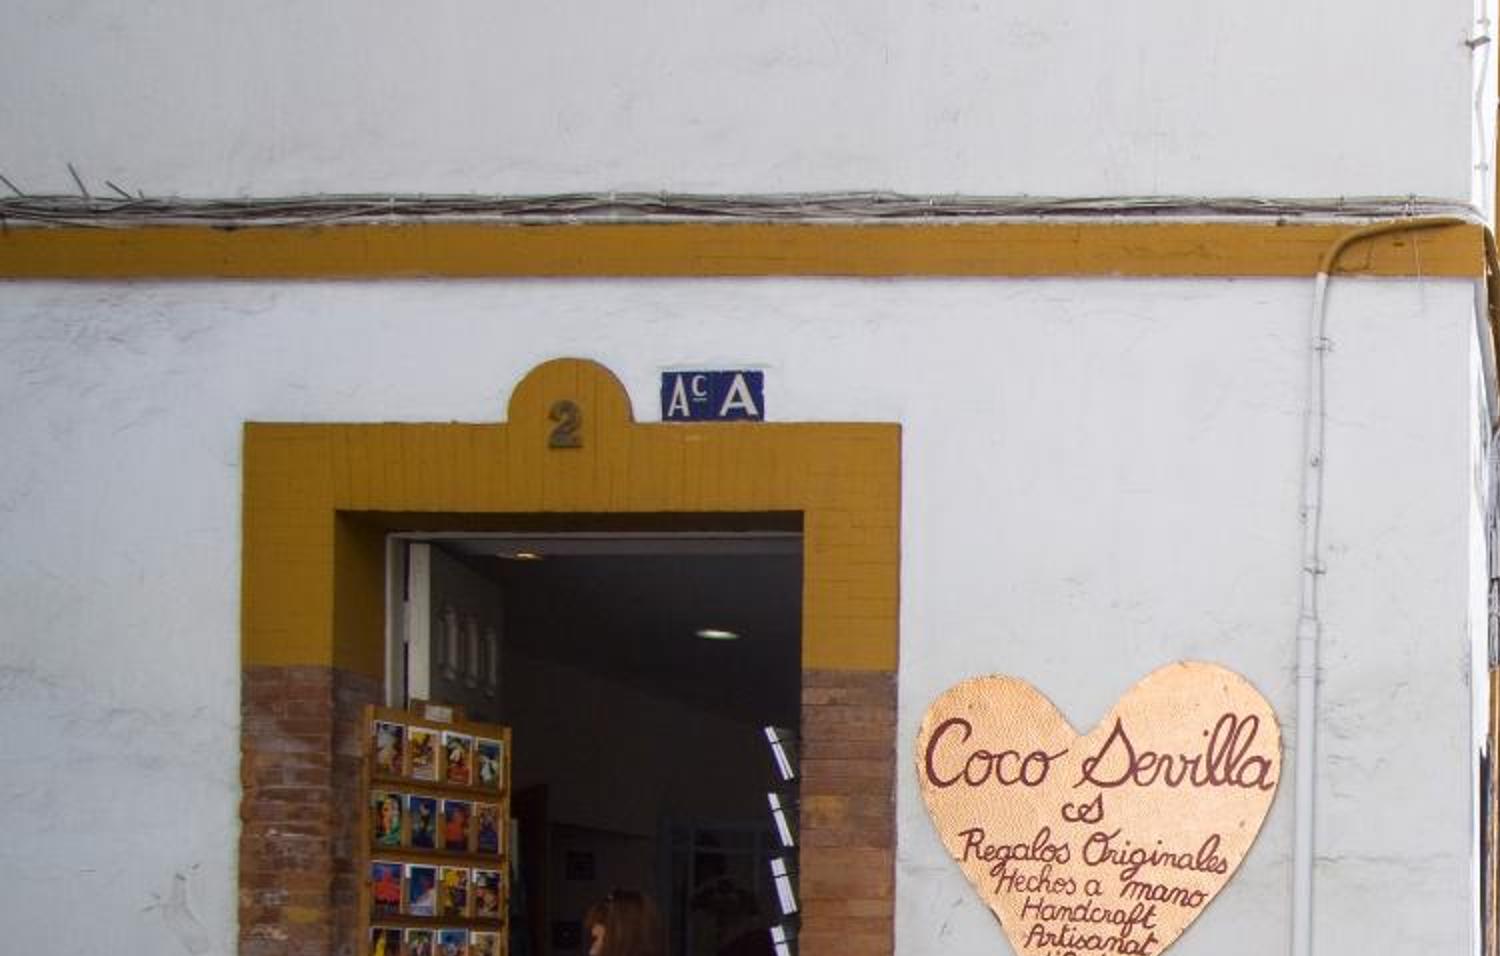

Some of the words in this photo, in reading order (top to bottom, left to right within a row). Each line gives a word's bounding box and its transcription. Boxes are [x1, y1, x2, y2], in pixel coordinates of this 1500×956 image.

[719, 373, 759, 417] A
[547, 400, 583, 450] 2
[925, 717, 1069, 789] Coco
[1072, 712, 1275, 790] Sevilla
[958, 827, 1072, 876] Regalos
[1082, 828, 1228, 880] Originales
[994, 862, 1077, 896] Hechos
[1083, 880, 1104, 896] a
[1119, 876, 1209, 908] mano
[1020, 896, 1157, 935] Handcraft
[1023, 923, 1158, 956] Artisanat
